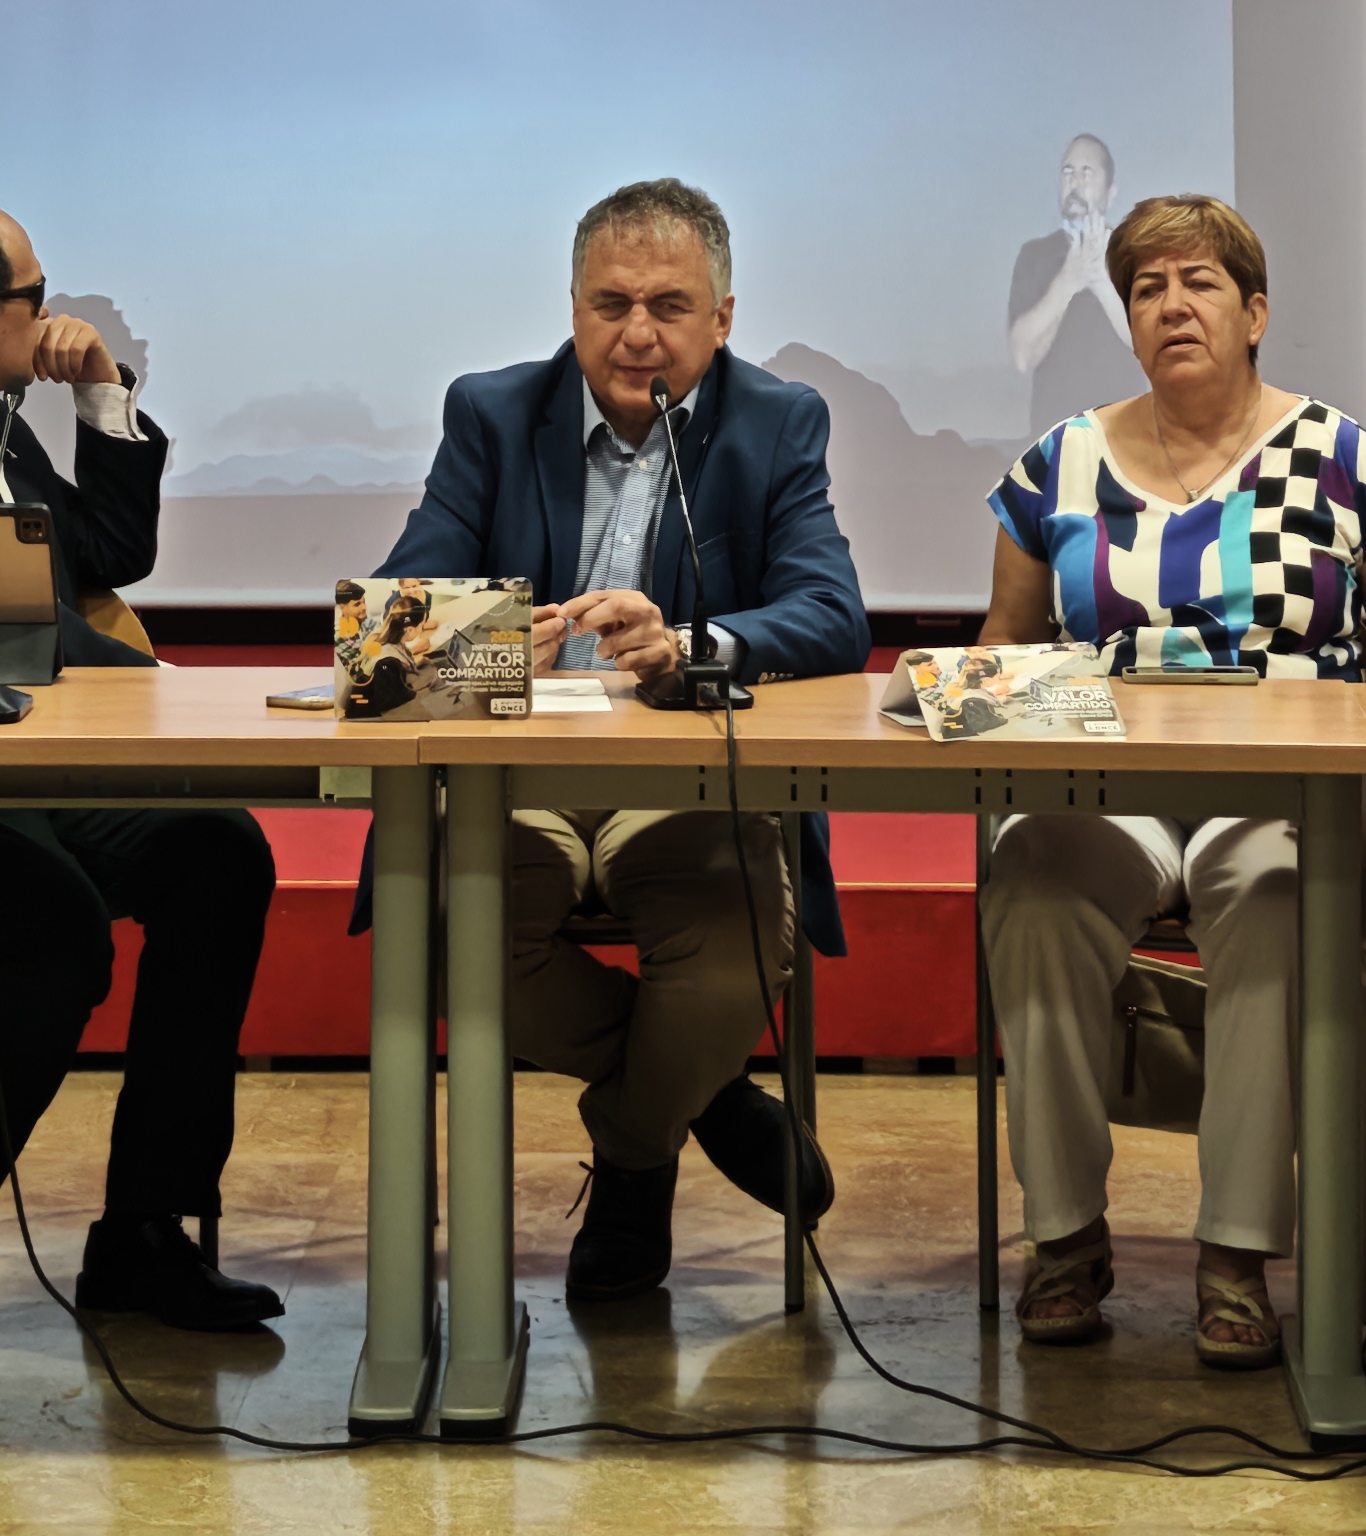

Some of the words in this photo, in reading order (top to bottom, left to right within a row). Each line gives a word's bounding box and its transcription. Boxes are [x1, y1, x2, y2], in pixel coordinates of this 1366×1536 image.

[460, 652, 525, 667] VALOR
[437, 667, 525, 679] COMPARTIDO
[1042, 690, 1108, 702] VALOR
[1024, 701, 1111, 711] COMPARTIDO
